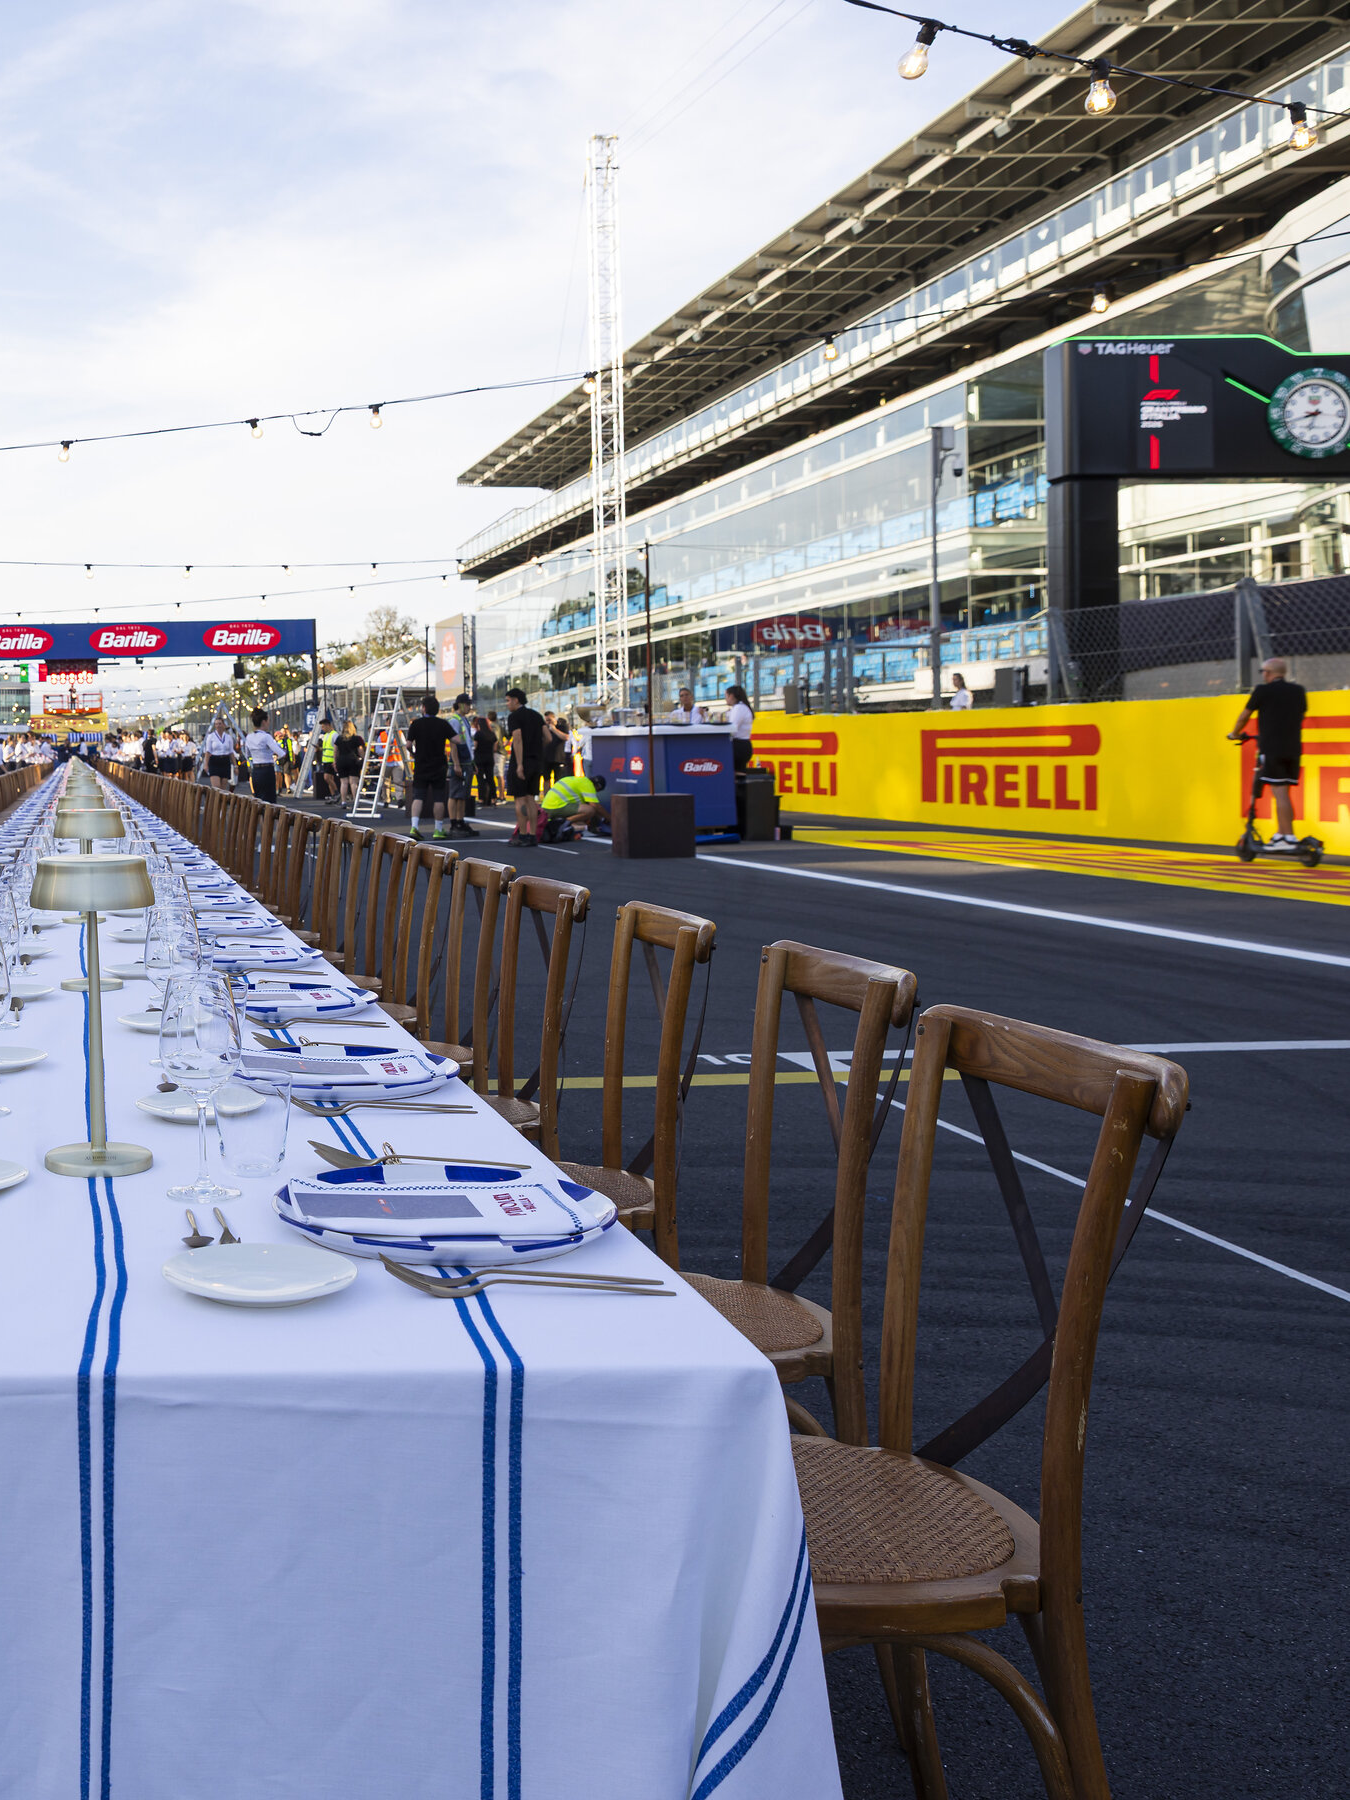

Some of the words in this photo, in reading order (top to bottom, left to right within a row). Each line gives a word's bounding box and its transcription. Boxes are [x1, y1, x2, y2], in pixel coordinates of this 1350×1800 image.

[98, 631, 158, 648] Barilla
[212, 629, 271, 646] Barilla
[684, 762, 719, 772] Barilla
[749, 732, 838, 796] PELLI
[921, 724, 1101, 811] PIRELLI
